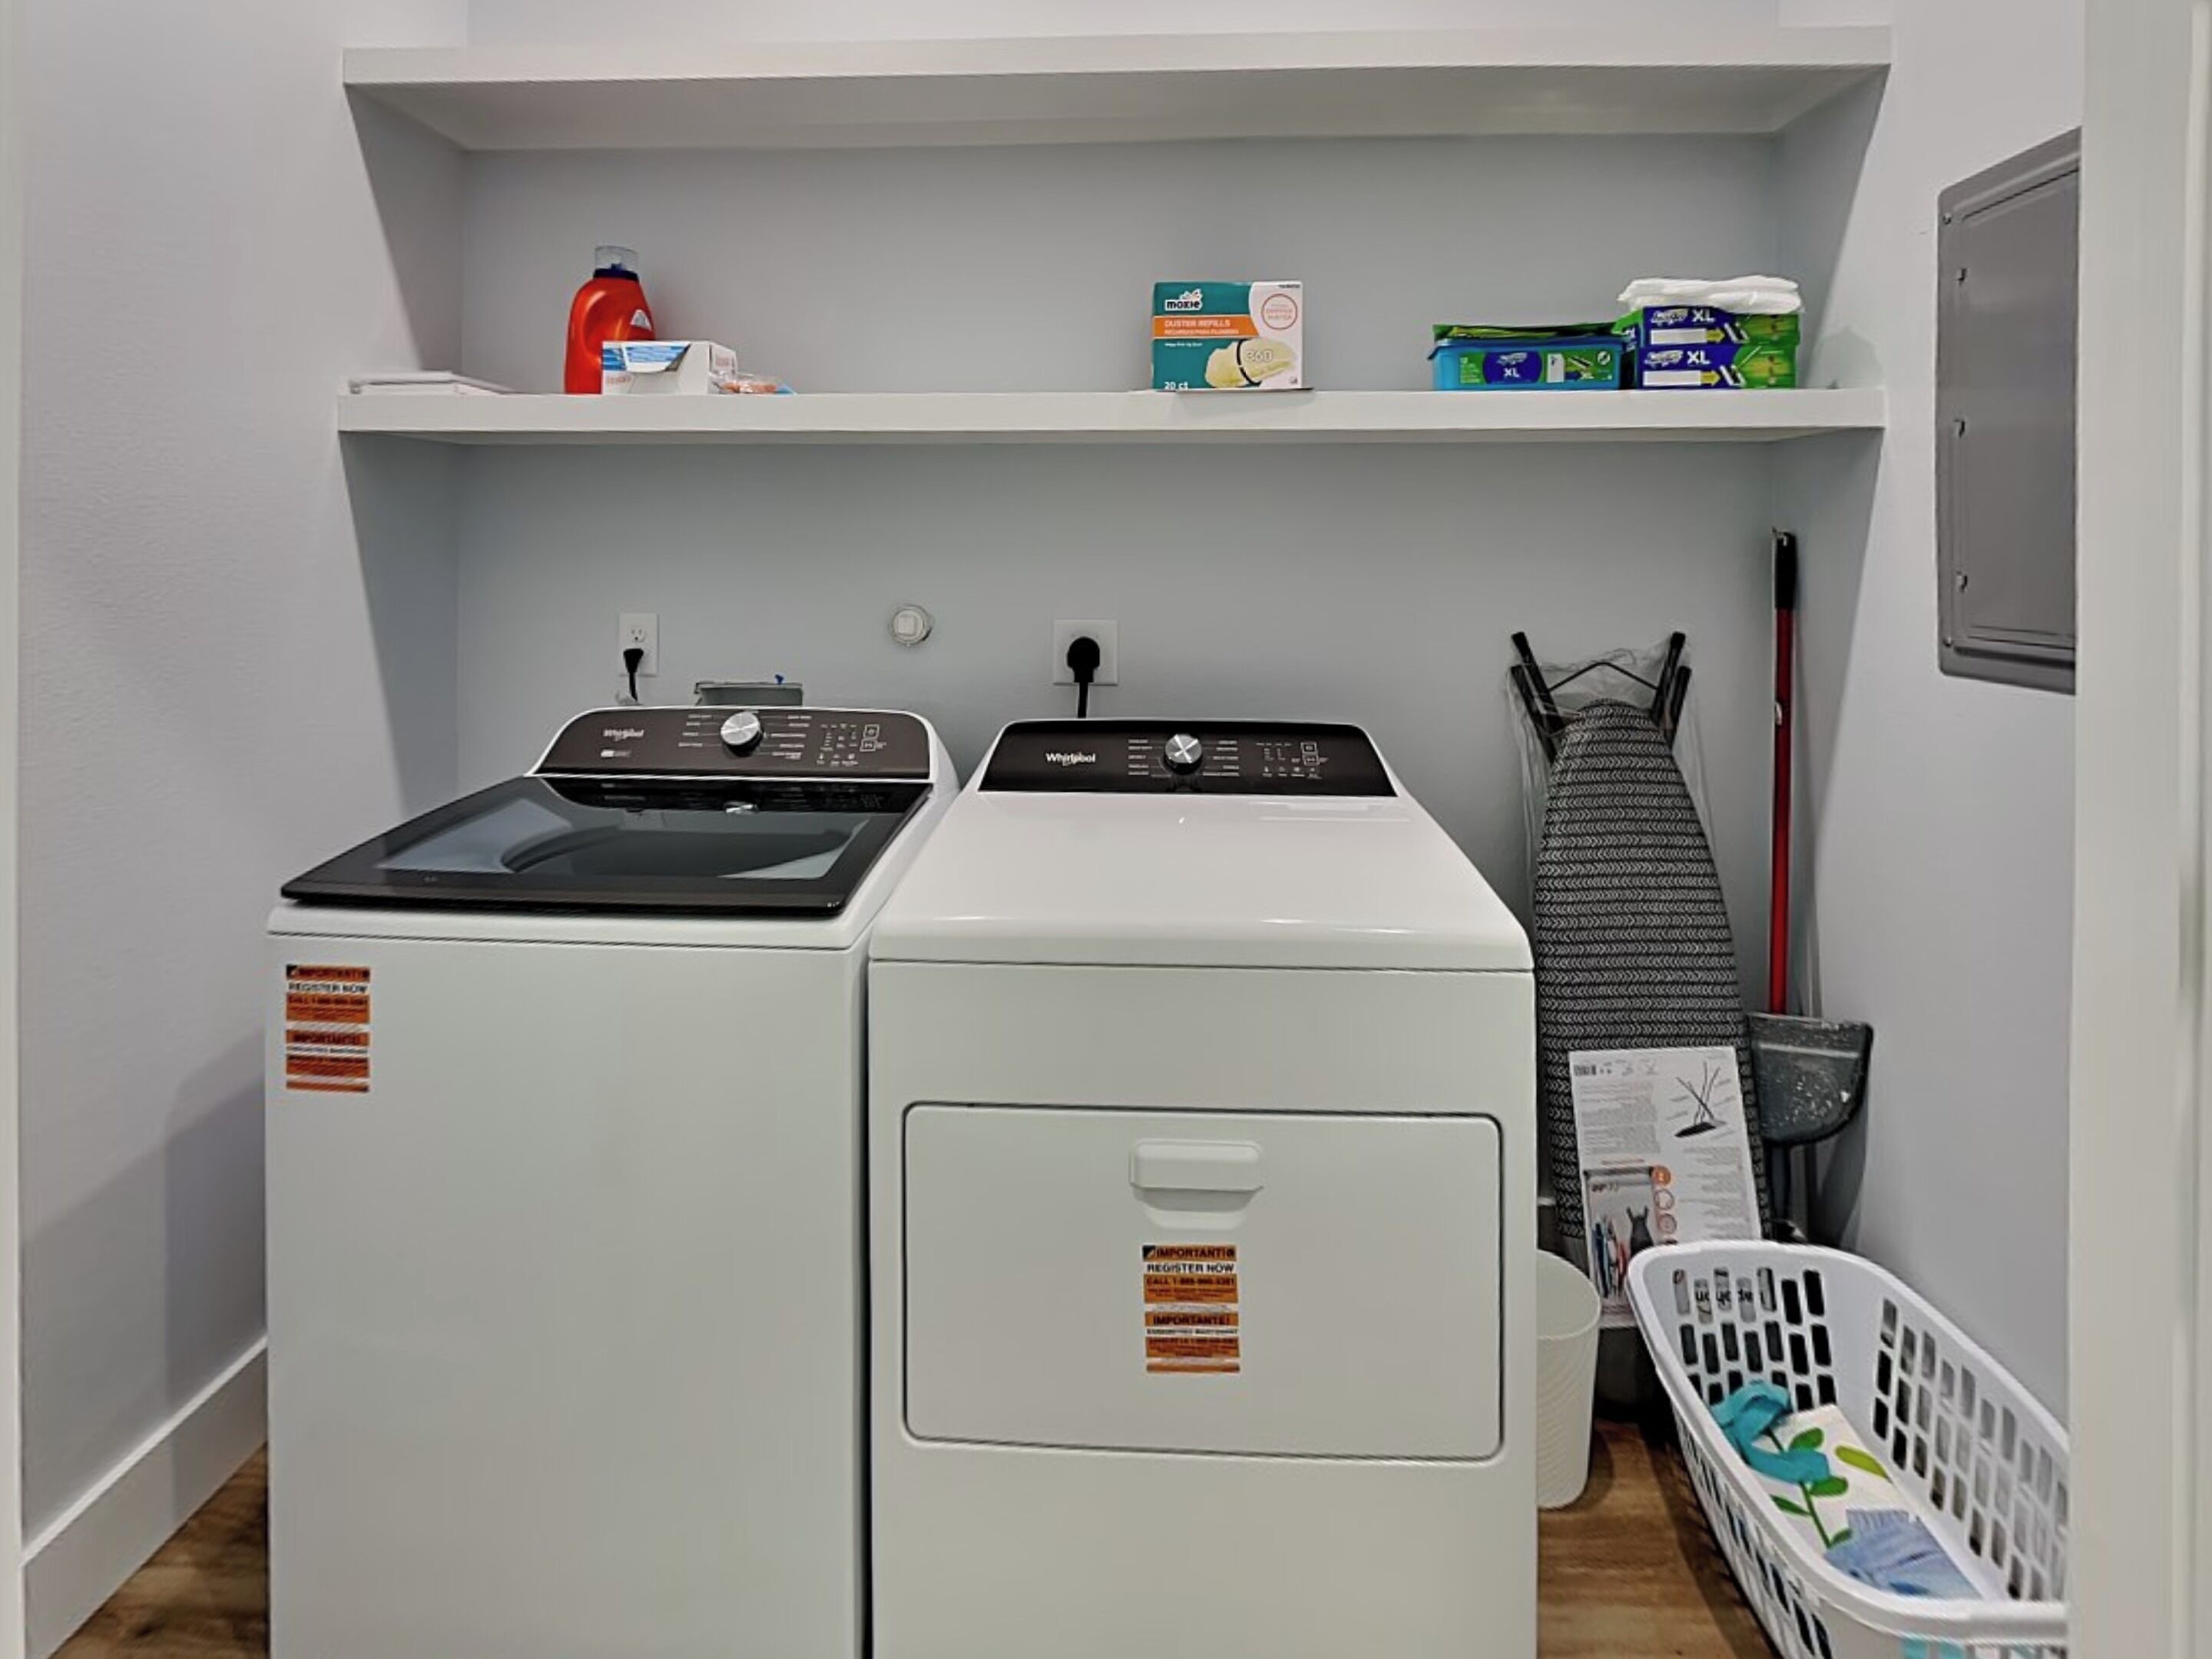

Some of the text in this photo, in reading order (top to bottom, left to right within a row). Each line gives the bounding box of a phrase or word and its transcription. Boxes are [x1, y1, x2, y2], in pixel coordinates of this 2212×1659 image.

[1166, 300, 1200, 309] moxie
[1691, 309, 1716, 323] XL
[1246, 349, 1273, 363] 360
[1687, 350, 1710, 364] XL
[1504, 368, 1520, 378] XL
[1045, 752, 1096, 767] Whirlpool
[1147, 1263, 1234, 1273] REGISTER NOW
